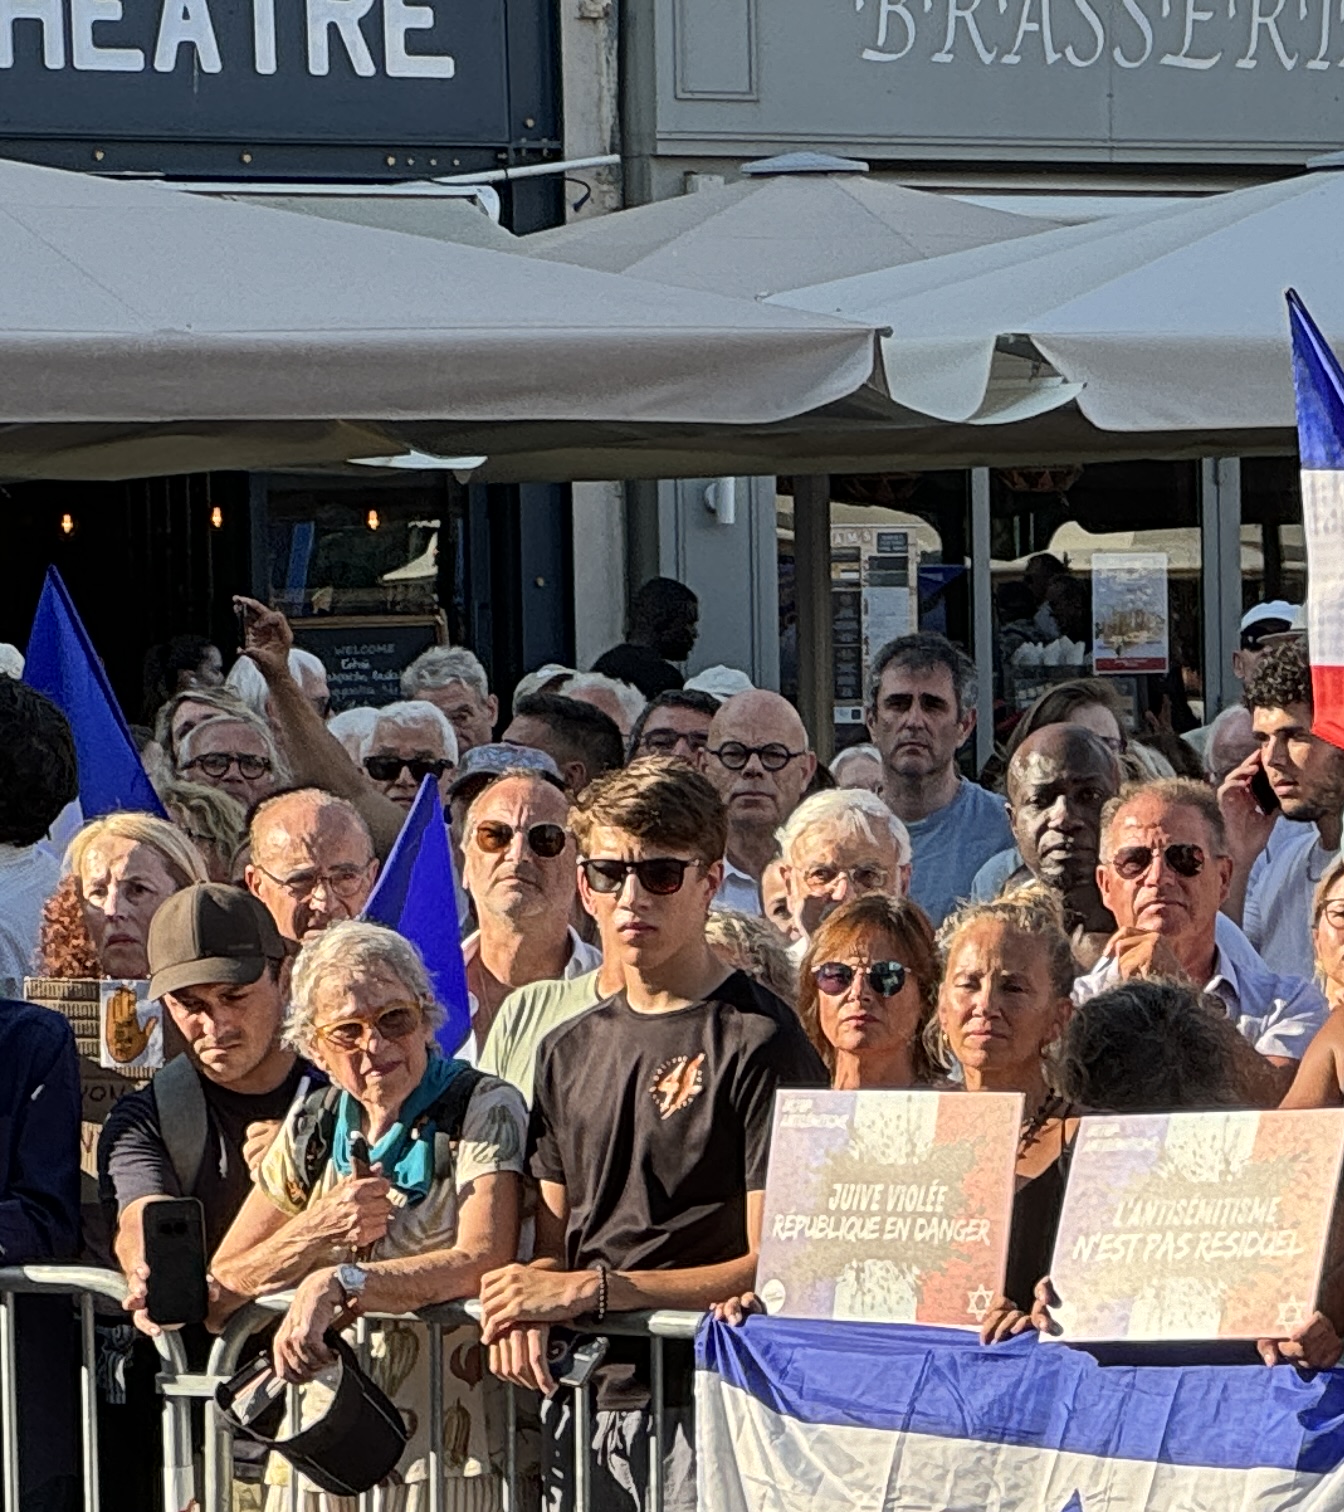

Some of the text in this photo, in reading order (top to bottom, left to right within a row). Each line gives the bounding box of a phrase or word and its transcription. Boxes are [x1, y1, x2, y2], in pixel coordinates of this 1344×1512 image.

[828, 1178, 949, 1213] JUIVE VIOLÉE
[772, 1208, 991, 1246] RÉPUBLIQUE EN DANGER
[1072, 1230, 1144, 1263] N'EST
[1142, 1230, 1194, 1263] PAS
